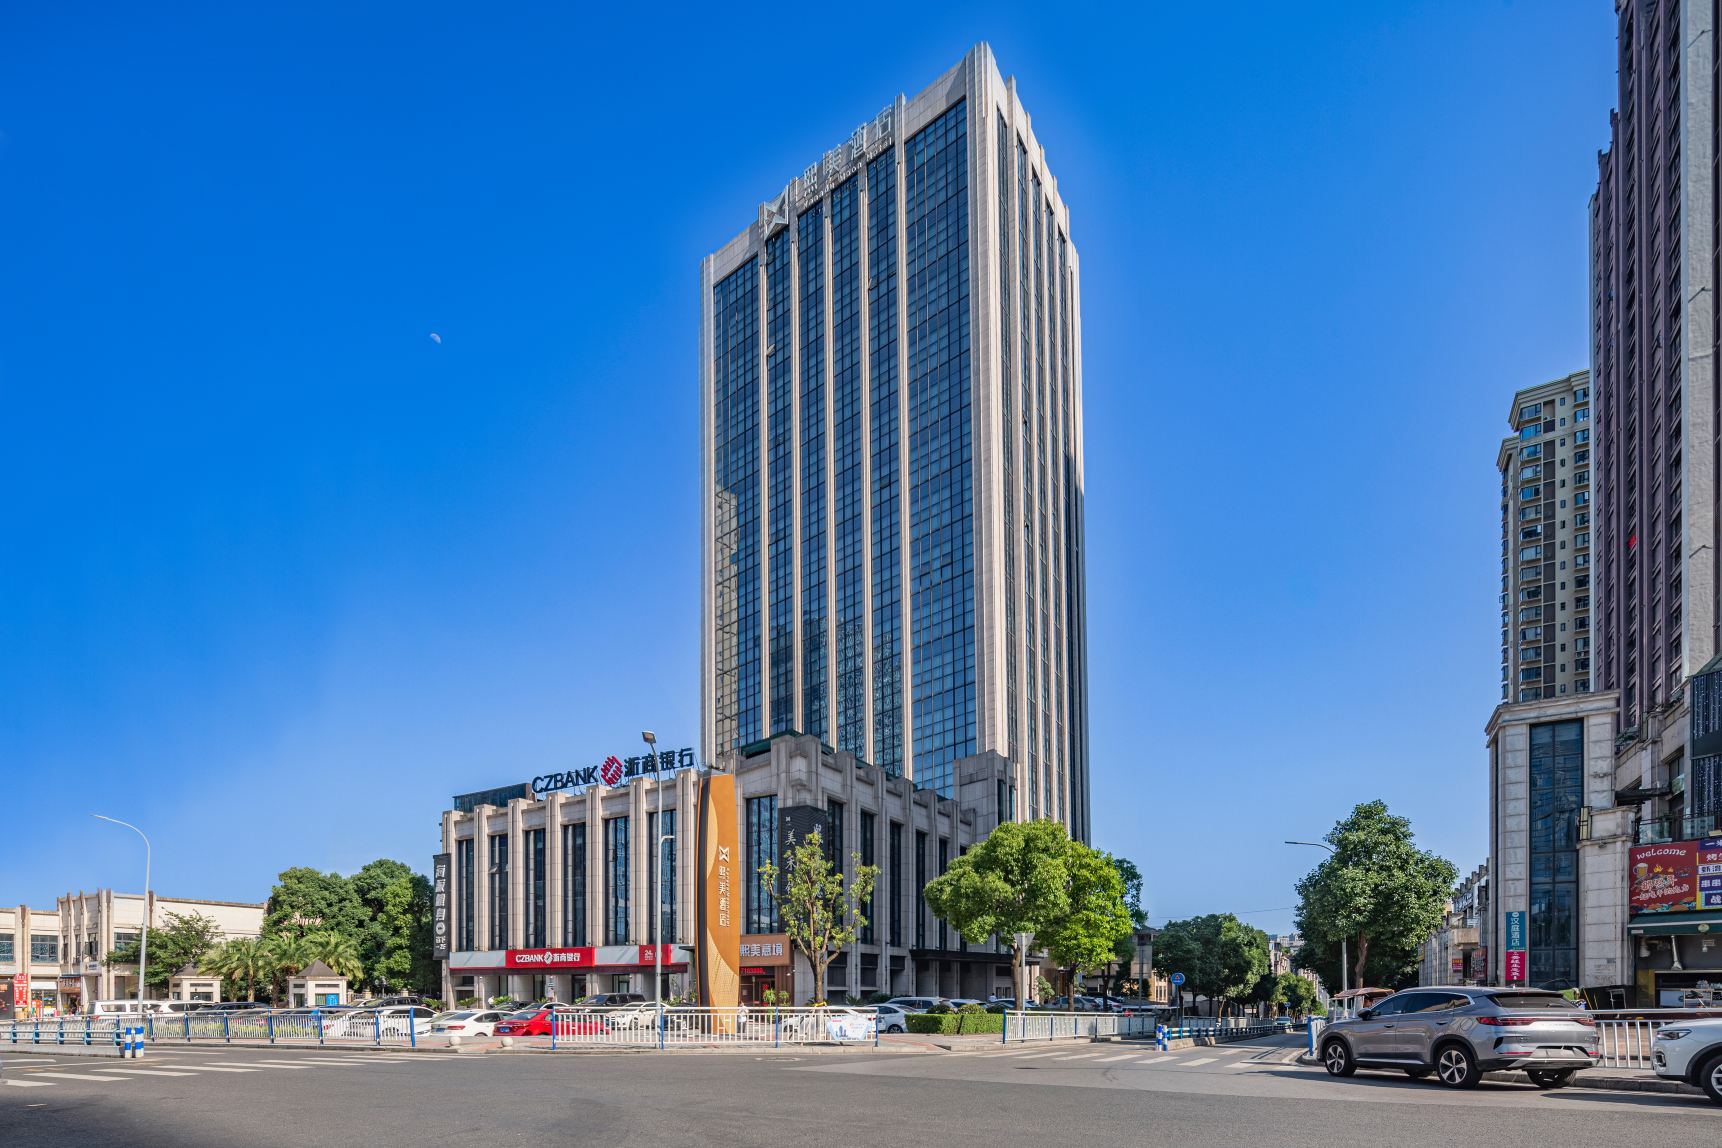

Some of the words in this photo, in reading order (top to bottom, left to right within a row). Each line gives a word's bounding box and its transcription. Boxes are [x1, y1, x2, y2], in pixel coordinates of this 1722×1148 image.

[624, 747, 694, 777] 浙商银行
[532, 765, 599, 793] CZBANK
[1636, 848, 1687, 860] welcome
[515, 954, 544, 963] CZBANK
